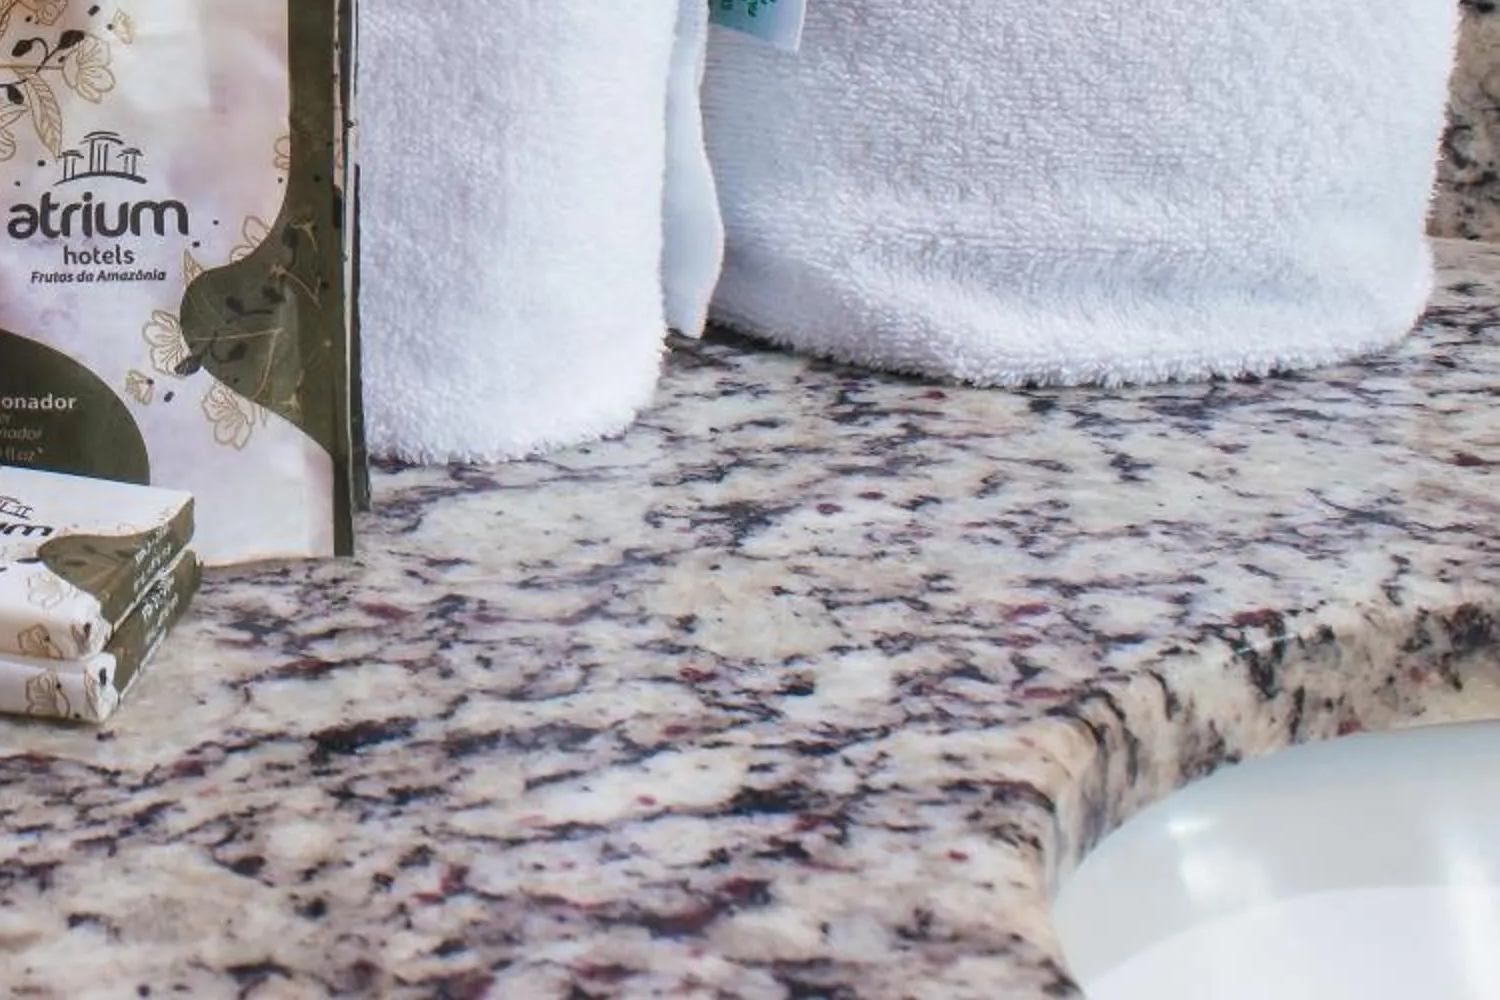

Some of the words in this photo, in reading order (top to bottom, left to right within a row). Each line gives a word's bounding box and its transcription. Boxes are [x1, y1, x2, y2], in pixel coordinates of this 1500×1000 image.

[7, 191, 189, 240] atrium
[63, 244, 135, 266] hotels
[76, 270, 94, 283] da
